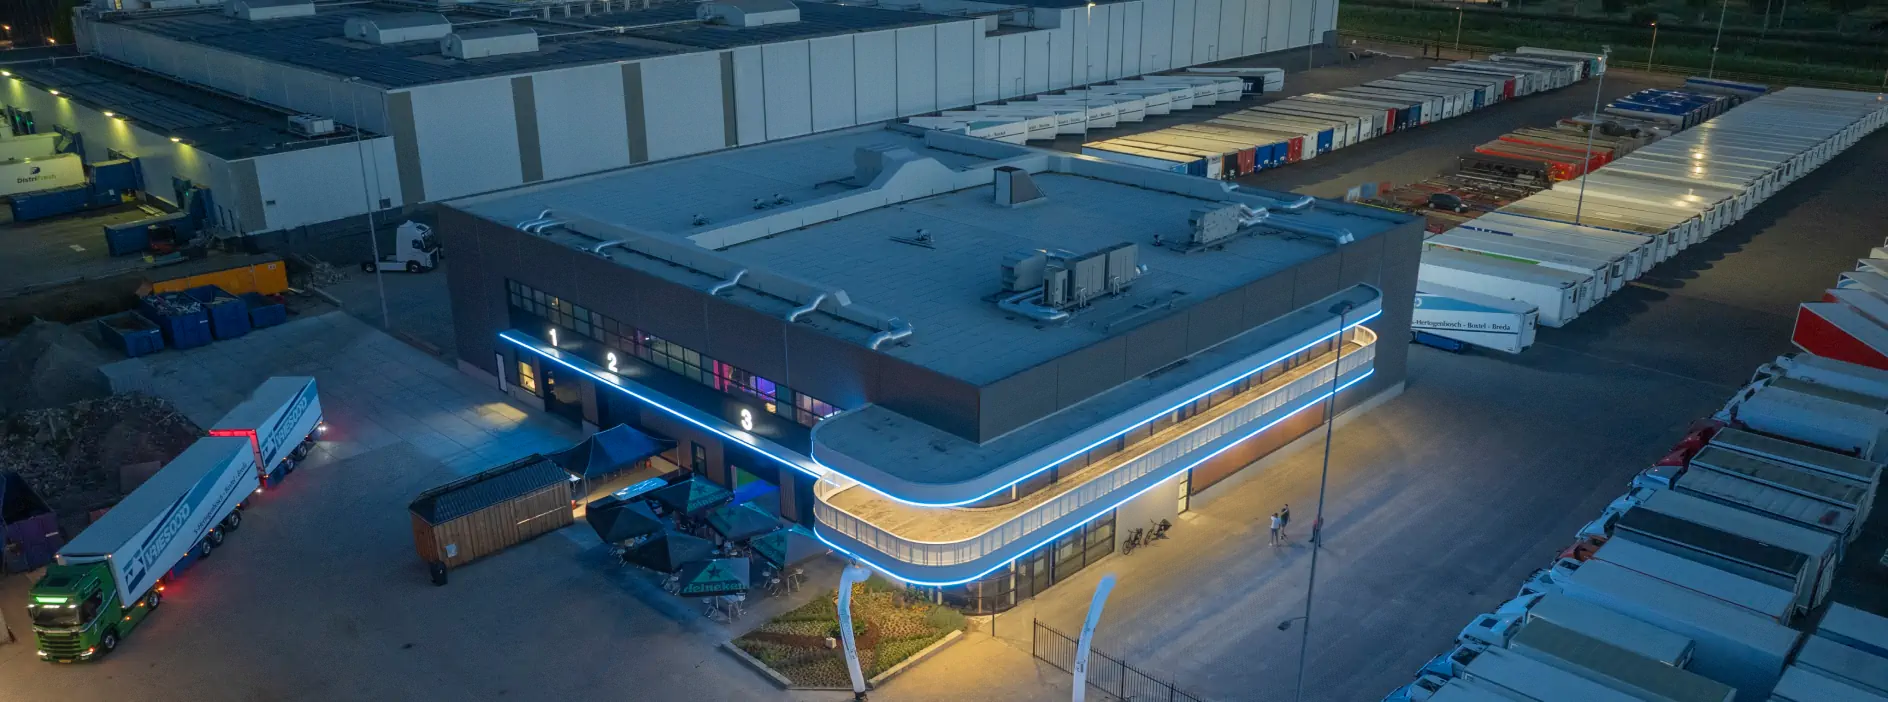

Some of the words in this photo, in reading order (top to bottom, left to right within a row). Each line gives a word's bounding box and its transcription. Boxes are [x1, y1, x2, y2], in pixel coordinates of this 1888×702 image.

[1492, 322, 1511, 331] Breda
[549, 328, 558, 347] 1
[607, 352, 618, 373] 2
[741, 408, 753, 431] 3
